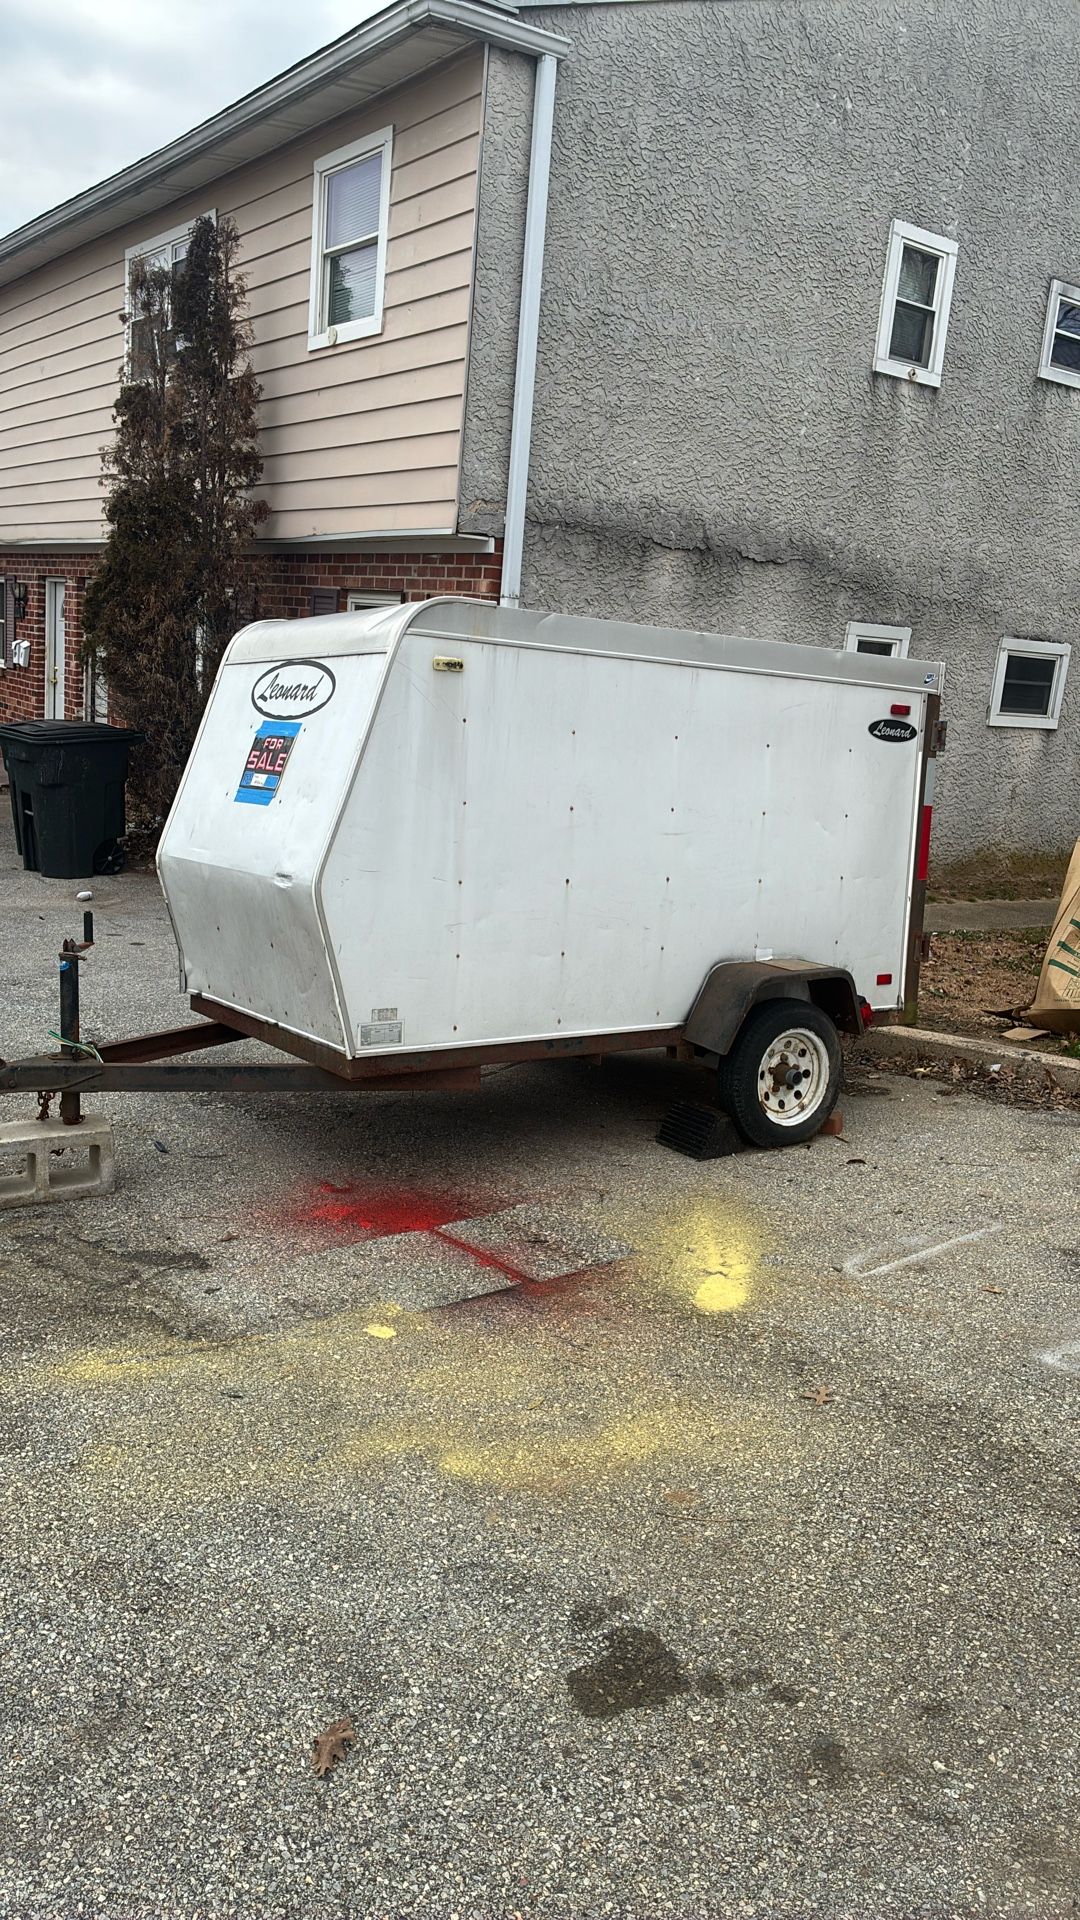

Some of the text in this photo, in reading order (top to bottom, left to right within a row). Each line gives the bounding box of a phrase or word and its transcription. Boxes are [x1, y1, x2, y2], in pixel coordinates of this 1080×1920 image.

[257, 672, 324, 702] Leonard
[873, 721, 912, 738] Leonard
[263, 737, 284, 749] FOR
[247, 750, 287, 771] SALE
